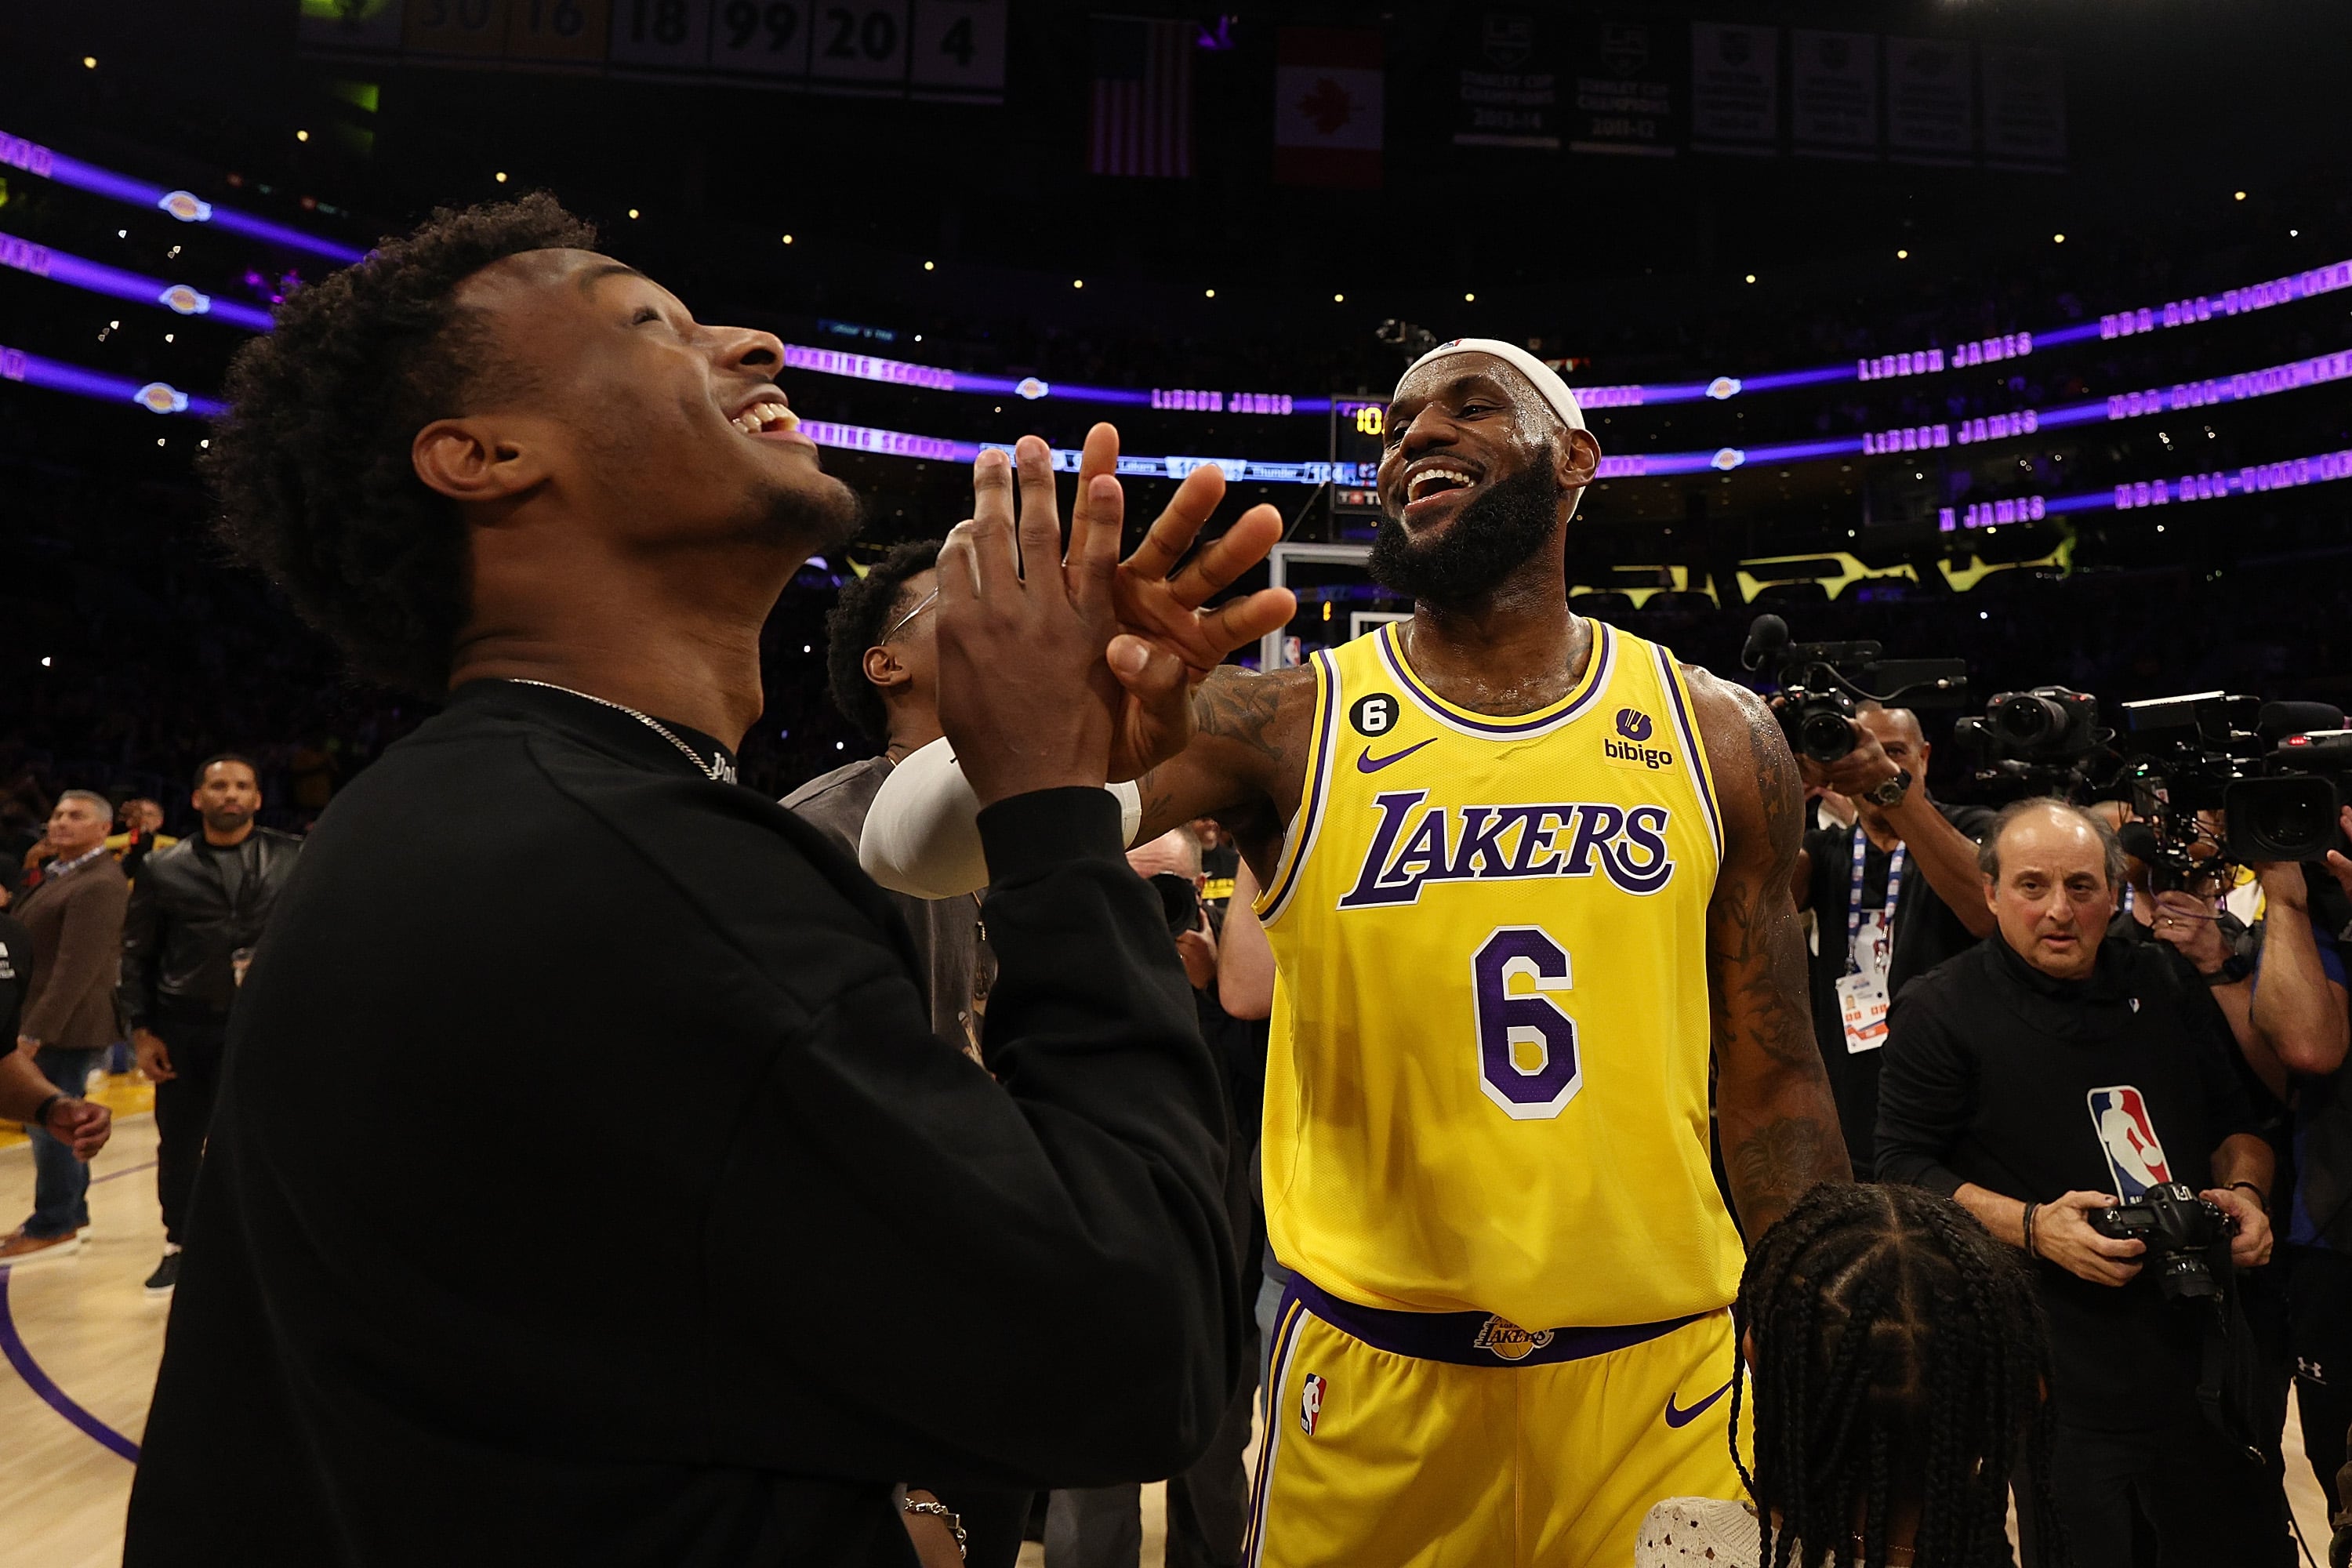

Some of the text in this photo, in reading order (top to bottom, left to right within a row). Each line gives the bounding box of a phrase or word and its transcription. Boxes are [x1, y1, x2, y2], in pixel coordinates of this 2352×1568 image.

[630, 0, 688, 45] 18
[724, 0, 799, 51] 99
[826, 7, 897, 61] 20
[940, 15, 975, 67] 4
[1951, 331, 2033, 368] JAMES
[880, 358, 954, 390] SCORER
[1228, 392, 1293, 416] JAMES
[1957, 409, 2038, 445] JAMES
[880, 430, 954, 461] SCORER
[1963, 495, 2046, 529] JAMES
[1362, 699, 1387, 731] 6
[1604, 739, 1672, 769] bibigo
[1336, 788, 1676, 910] LAKERS
[1469, 924, 1584, 1120] 6
